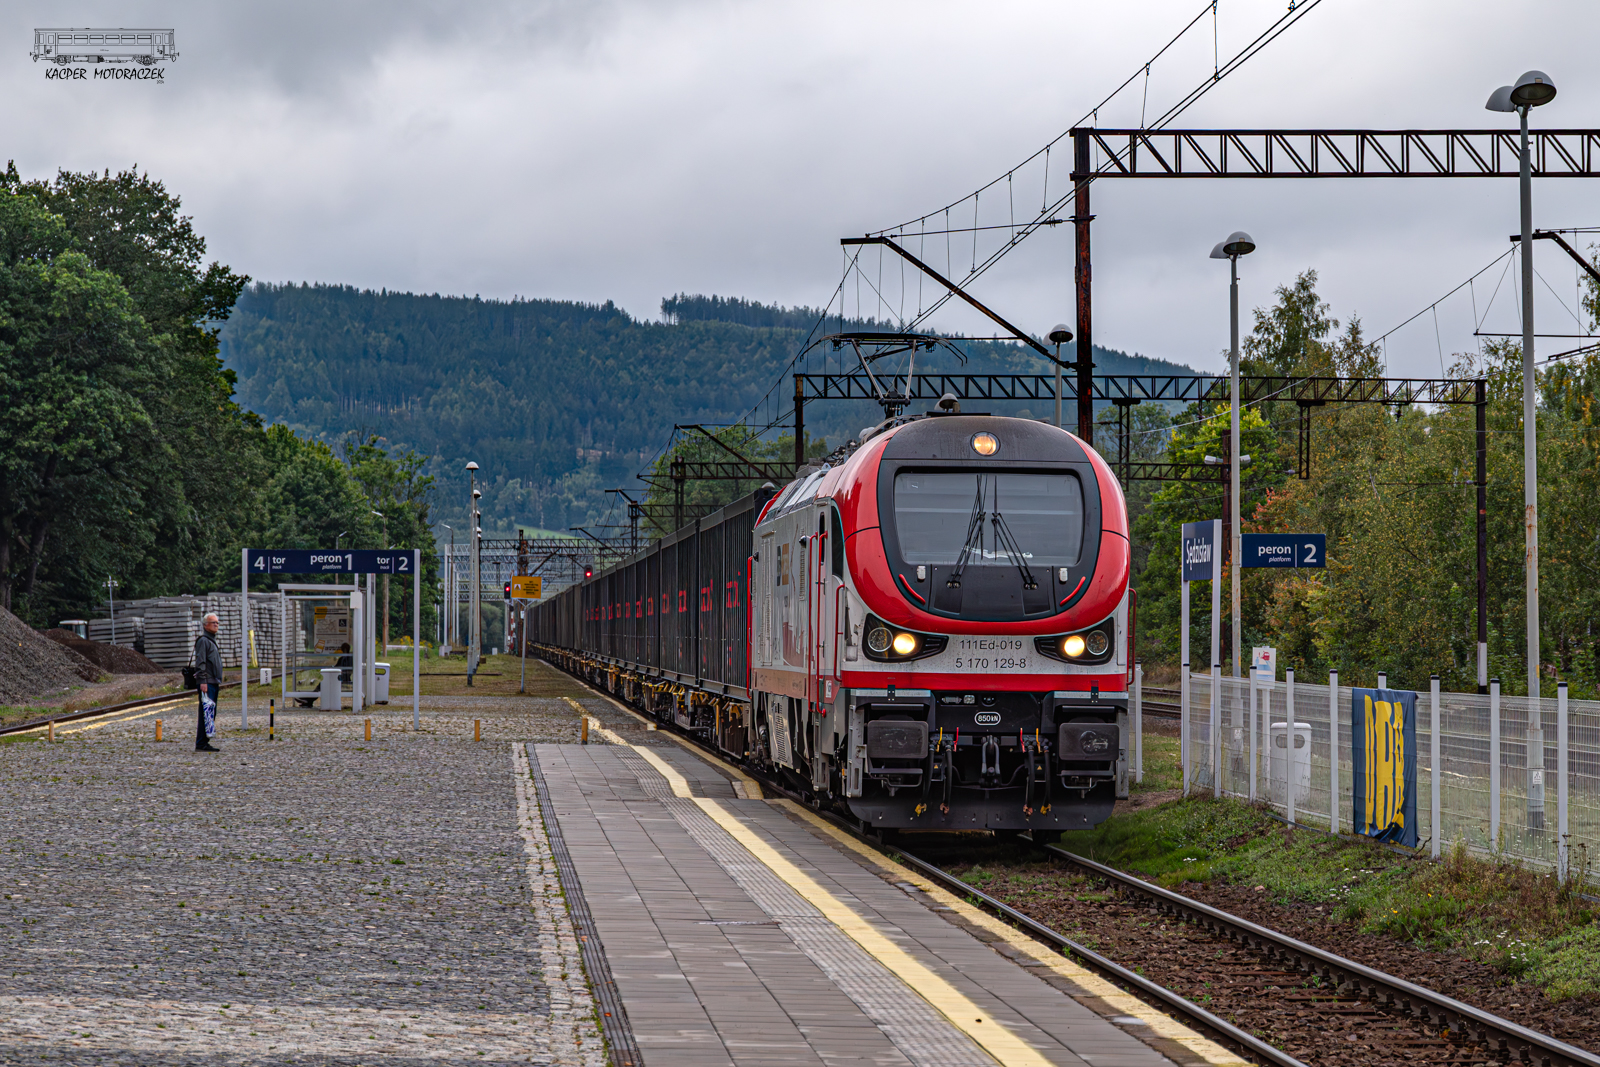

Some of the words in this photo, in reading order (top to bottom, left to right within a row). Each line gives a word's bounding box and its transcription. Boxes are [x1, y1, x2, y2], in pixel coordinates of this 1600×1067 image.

[1258, 545, 1292, 557] peron
[1303, 543, 1317, 563] 2
[1268, 556, 1292, 564] platform
[254, 556, 266, 571] 4
[272, 556, 286, 564] tor
[310, 554, 342, 565] peron
[344, 554, 352, 571] 1
[377, 556, 390, 565] tor
[398, 556, 409, 571] 2
[959, 640, 1022, 650] 111Ed-019
[955, 658, 963, 668] 5
[967, 658, 989, 668] 170
[993, 658, 1027, 668] 129-8
